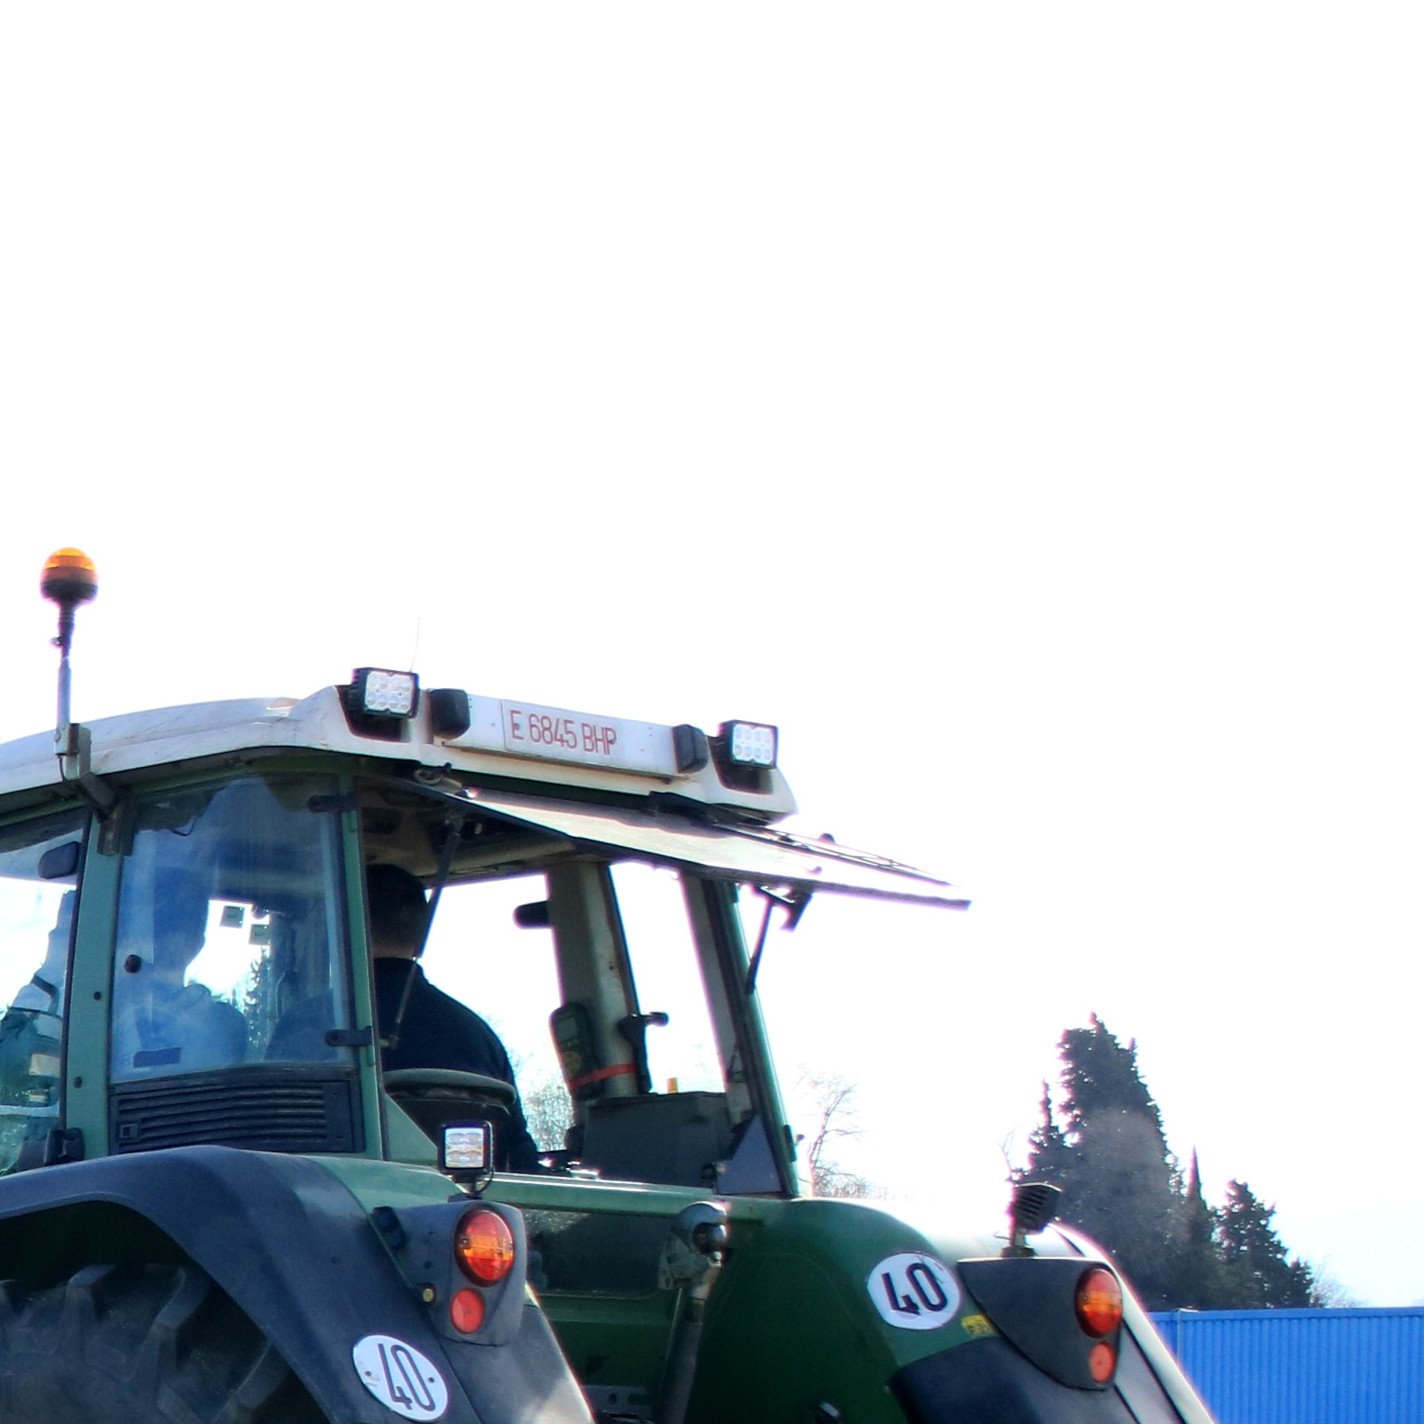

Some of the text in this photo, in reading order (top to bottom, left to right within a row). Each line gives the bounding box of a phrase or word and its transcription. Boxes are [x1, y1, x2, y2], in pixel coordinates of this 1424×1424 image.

[510, 709, 617, 755] E 6845 BHP
[881, 1262, 948, 1316] 40
[377, 1343, 436, 1412] 40
